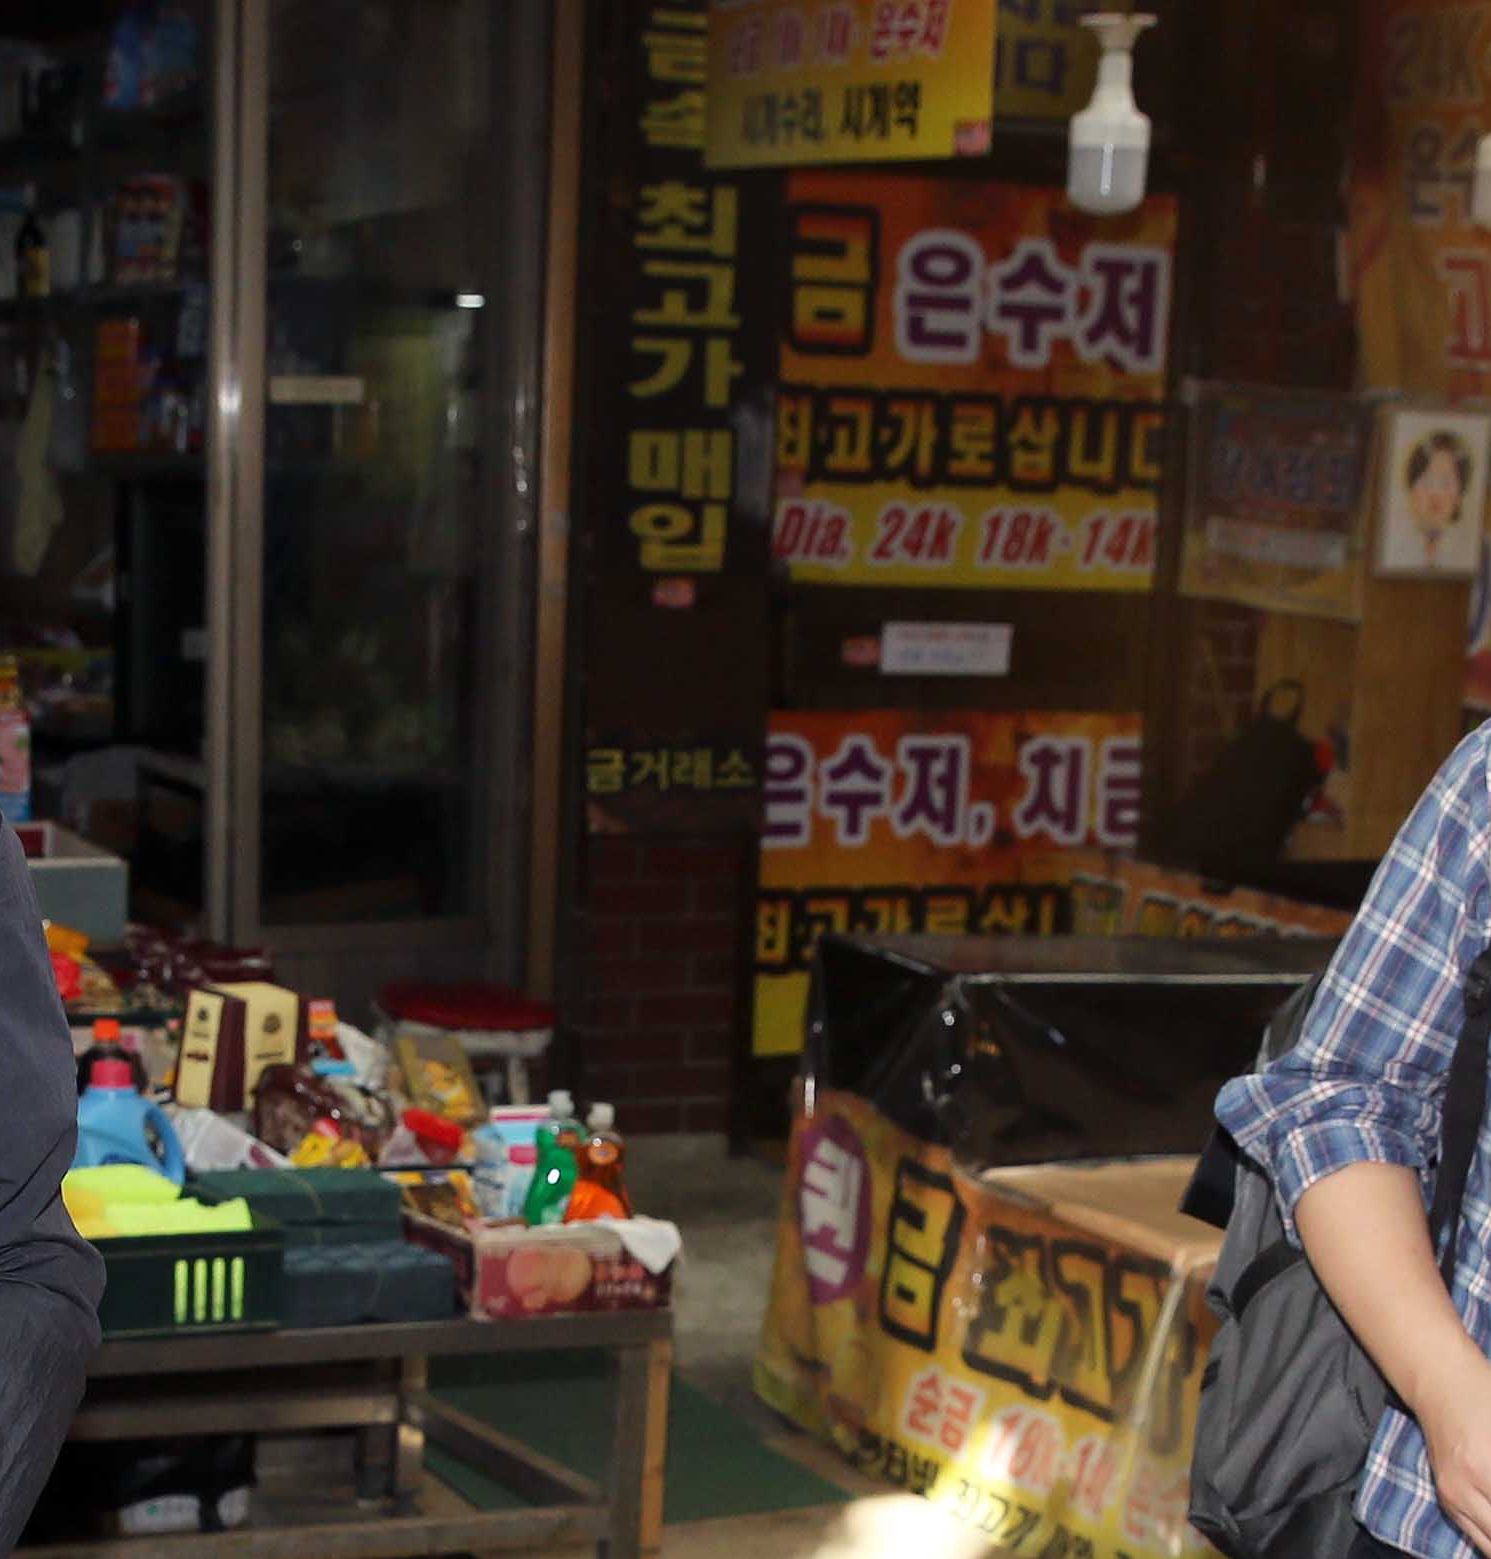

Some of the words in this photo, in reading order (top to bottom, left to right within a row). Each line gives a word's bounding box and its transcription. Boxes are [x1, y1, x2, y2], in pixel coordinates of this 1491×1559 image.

[628, 180, 739, 408] 최고가
[787, 208, 877, 354] 금
[895, 229, 1172, 372] 은수저
[628, 429, 736, 573] 매입
[587, 748, 758, 794] 금거래소
[903, 1371, 984, 1456] 순금
